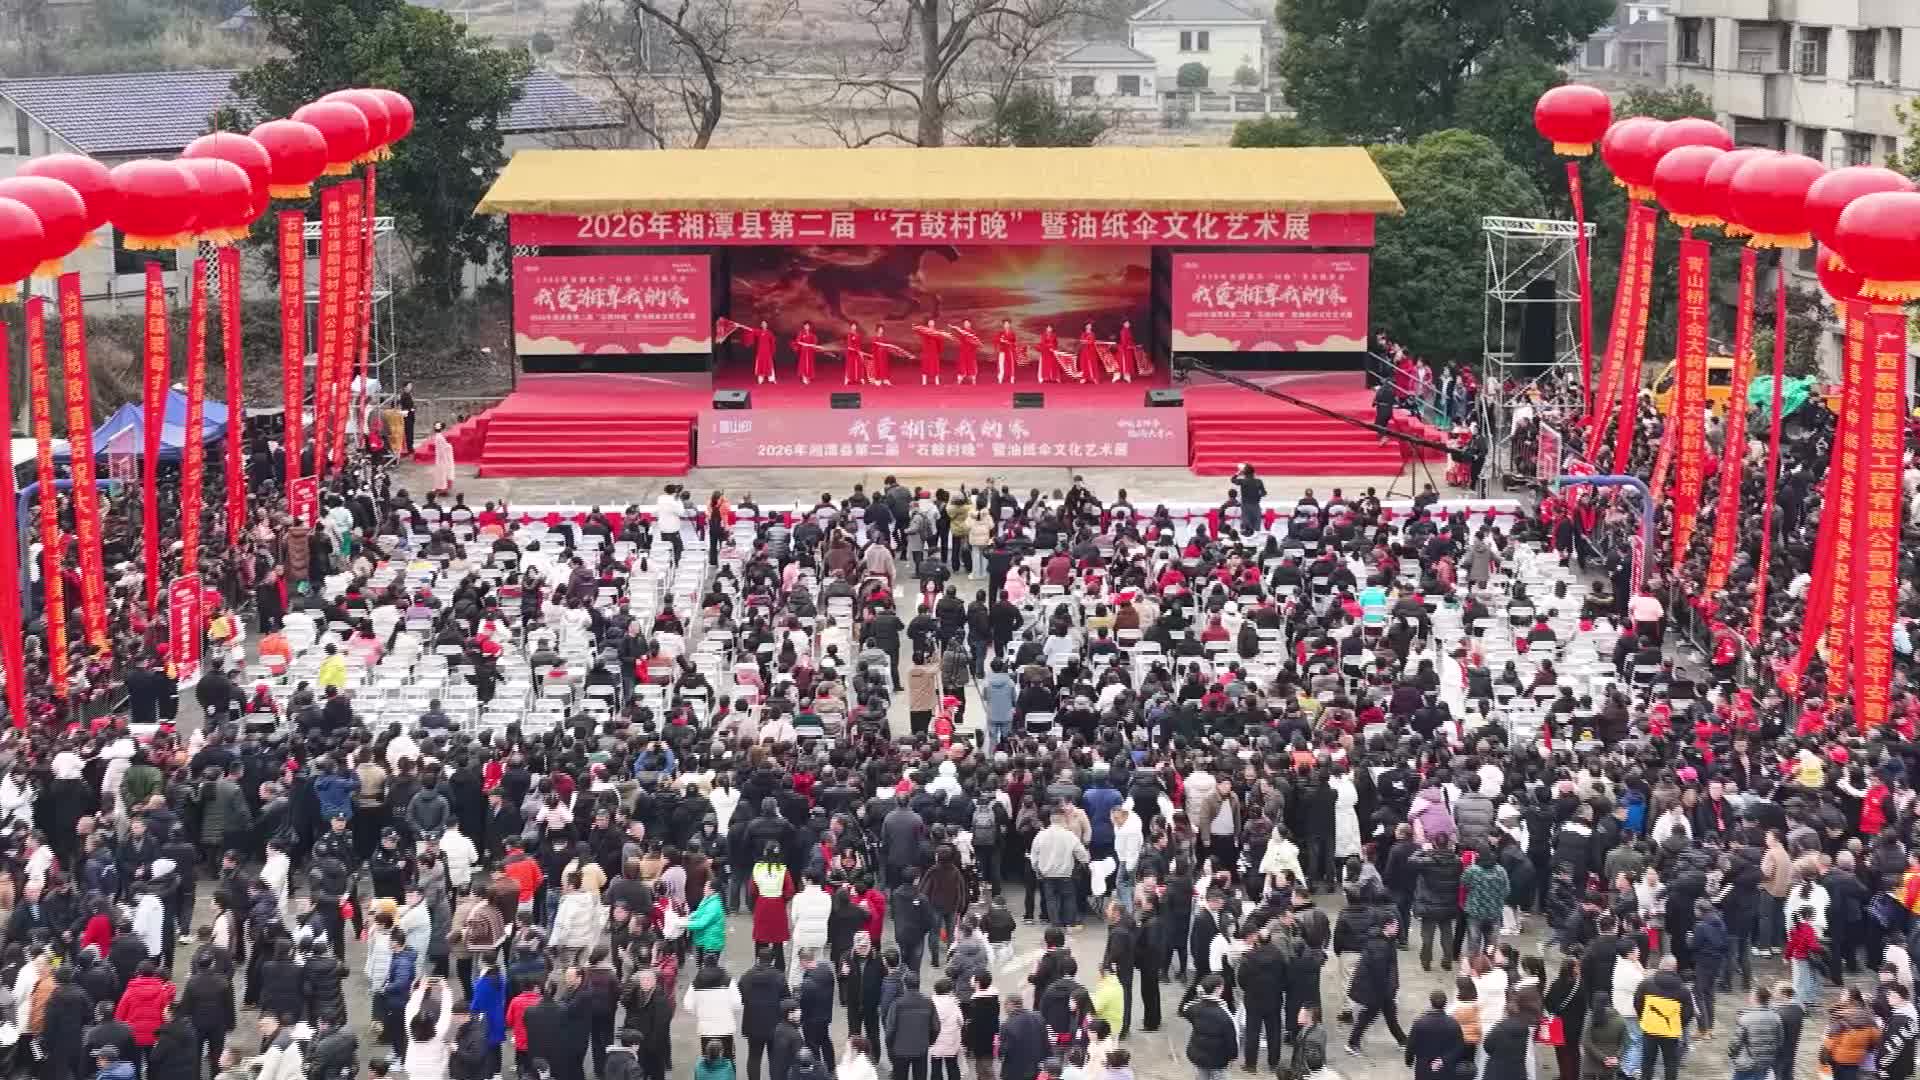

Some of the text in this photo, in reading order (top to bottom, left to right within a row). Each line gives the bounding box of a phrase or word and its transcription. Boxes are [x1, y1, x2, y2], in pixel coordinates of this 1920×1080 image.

[576, 211, 1311, 240] 2026年湘潭县第二届“石鼓村晚”暨油纸伞文化艺术展
